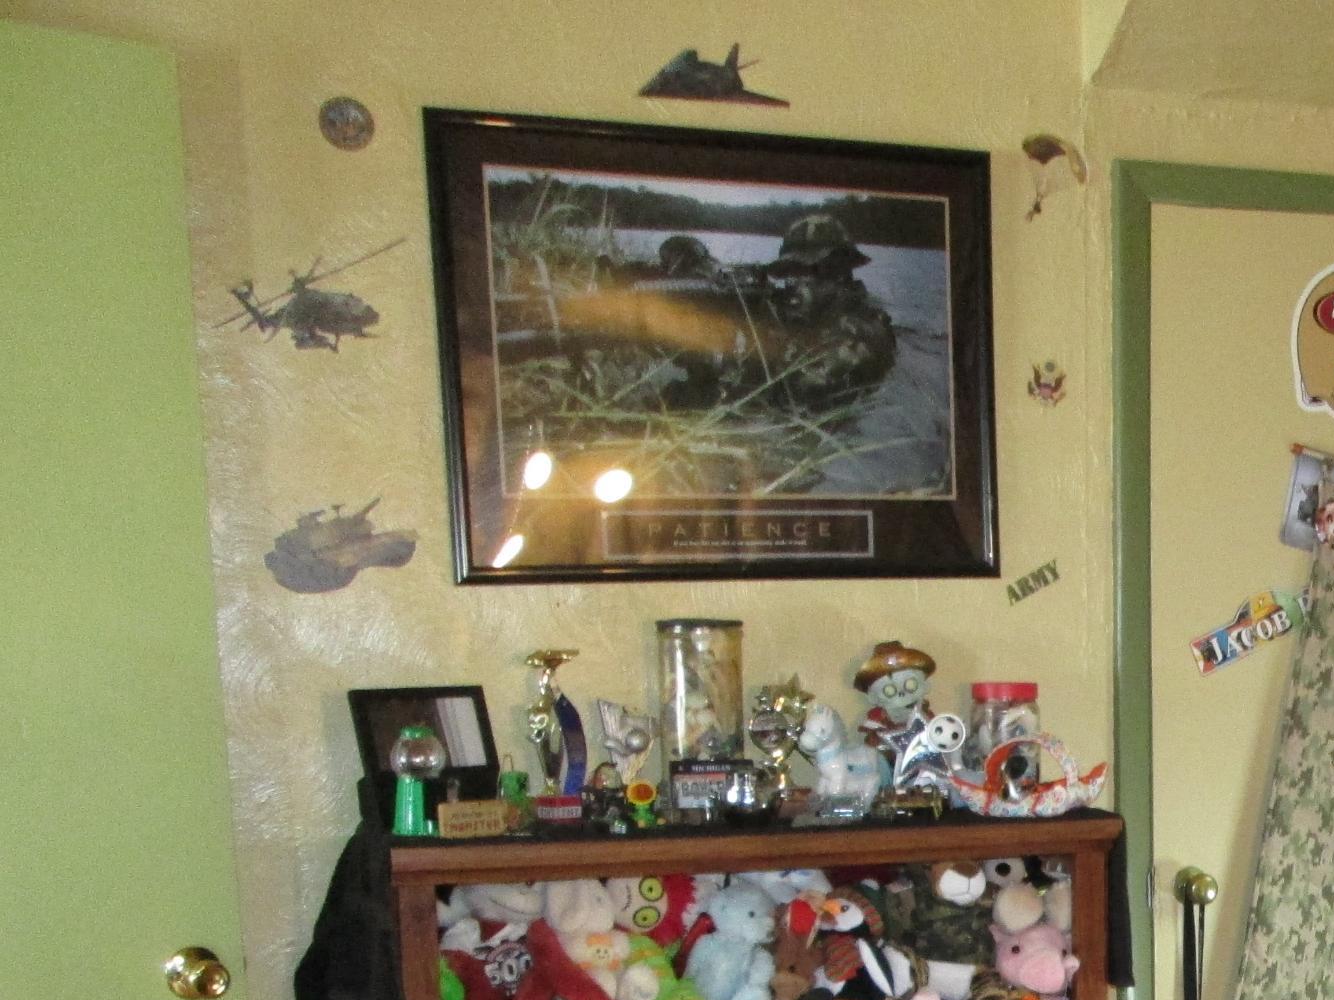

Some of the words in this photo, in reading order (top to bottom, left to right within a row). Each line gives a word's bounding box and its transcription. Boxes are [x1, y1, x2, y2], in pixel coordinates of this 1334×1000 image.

[649, 521, 832, 538] PATIENCE
[1006, 559, 1060, 607] ARMY
[1209, 609, 1292, 665] JACOB
